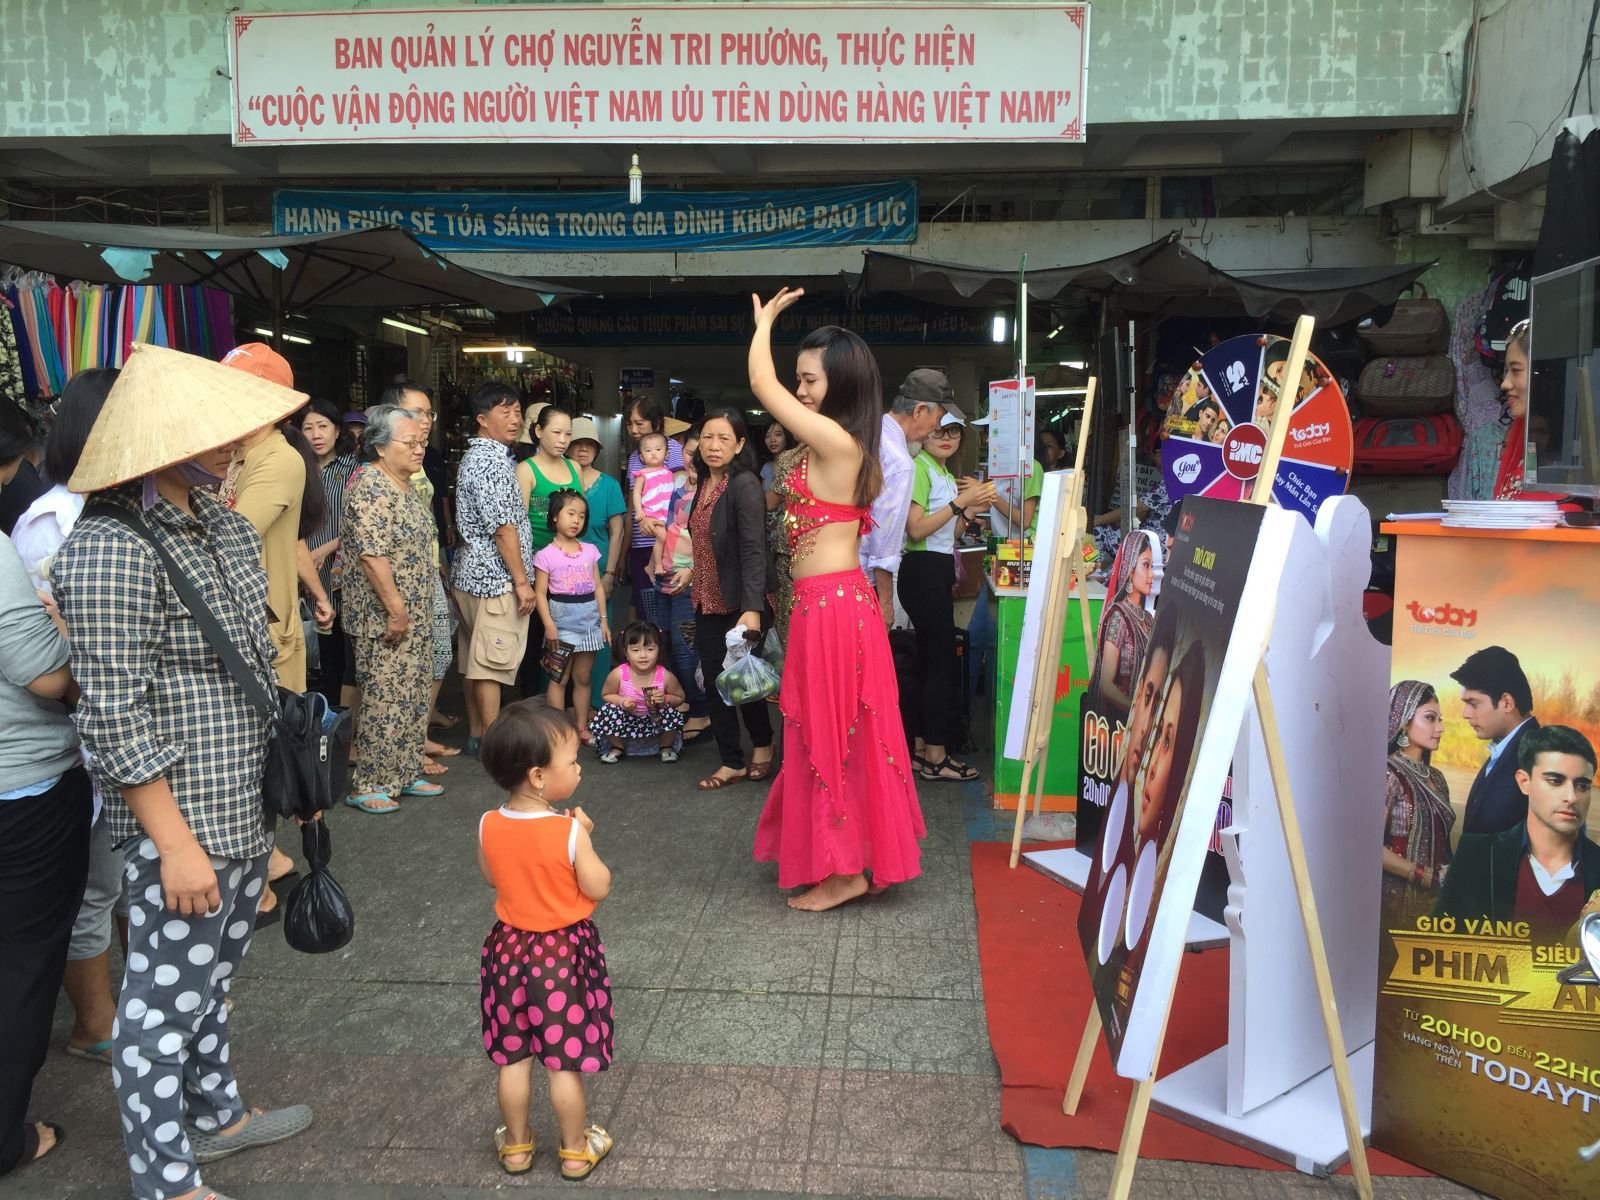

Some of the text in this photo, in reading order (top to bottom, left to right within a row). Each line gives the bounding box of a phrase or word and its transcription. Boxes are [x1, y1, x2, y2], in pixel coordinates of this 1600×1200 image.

[335, 17, 975, 74] BAN QUẢN LÝ CHỢ NGUYỄN TRI PHƯƠNG, THỰC HIỆN
[248, 82, 1071, 132] “CUỘC VẬN ĐỘNG NGƯỜI VIỆT NAM ƯU TIÊN DÙNG HÀNG VIỆT NAM”
[285, 207, 341, 235] HẠNH
[411, 207, 437, 235] SẼ
[444, 203, 487, 236] TỎA
[494, 206, 550, 237] SÁNG
[555, 211, 626, 237] TRONG
[632, 211, 667, 236] GIA
[674, 204, 724, 235] ĐÌNH
[732, 202, 806, 233] KHÔNG
[814, 204, 857, 233] BẠO
[864, 196, 907, 232] LỰC
[537, 312, 574, 334] KHÔNG
[617, 312, 639, 332] CÁO
[641, 312, 671, 335] THỰC
[710, 314, 727, 332] SAI
[1288, 471, 1317, 500] Chúc Bạn
[1416, 912, 1531, 938] GIỜ VÀNG
[1412, 947, 1509, 985] PHIM
[1535, 942, 1580, 963] SIÊU
[1403, 1031, 1461, 1058] HÀNG NGÀY
[1404, 1007, 1419, 1021] TỪ
[1421, 1014, 1502, 1054] 20H00
[1507, 1044, 1532, 1060] ĐẾN
[1435, 1053, 1461, 1068] TRÊN
[1465, 1051, 1600, 1113] TODAYT
